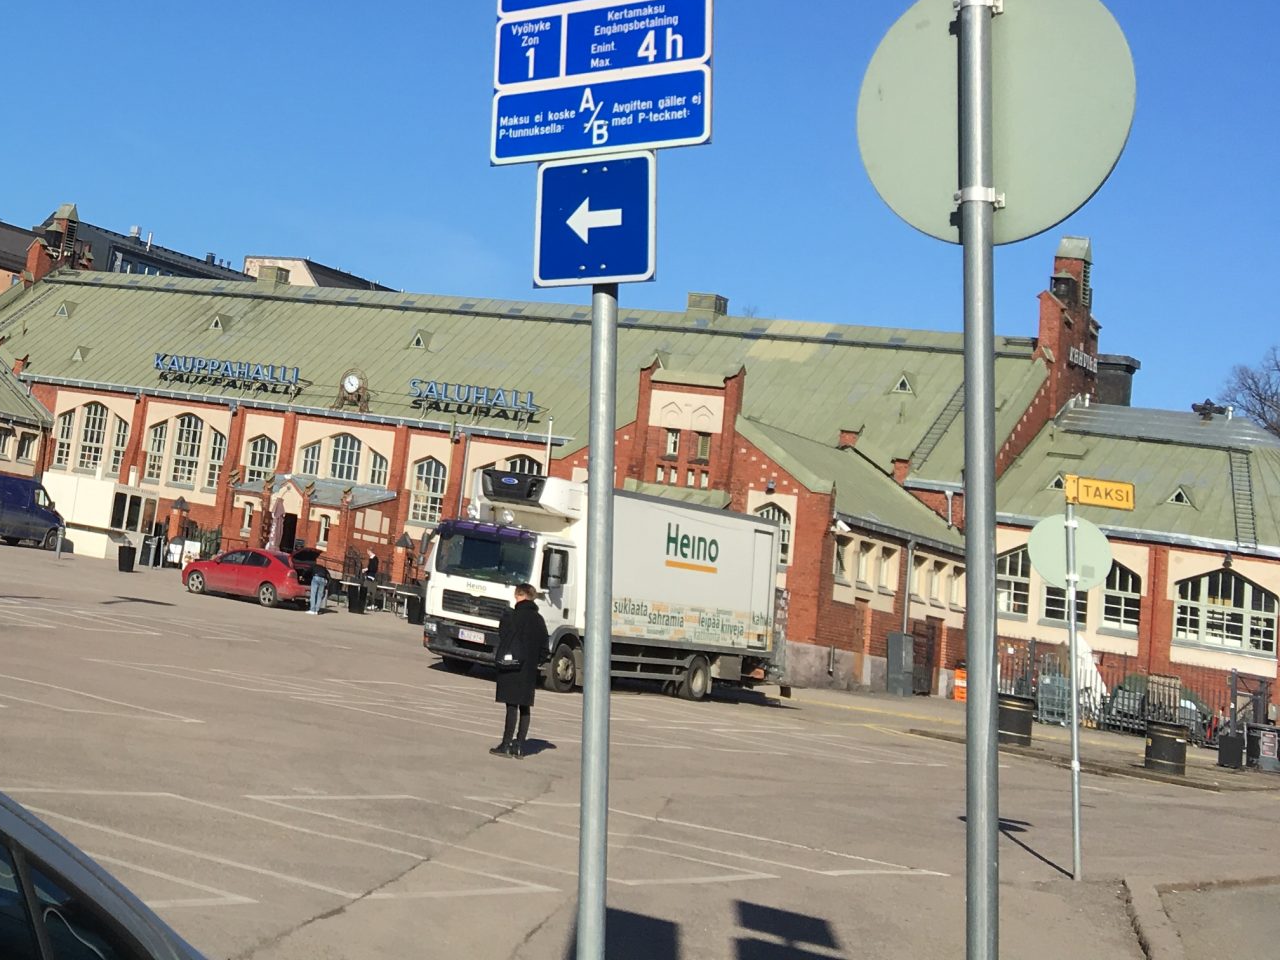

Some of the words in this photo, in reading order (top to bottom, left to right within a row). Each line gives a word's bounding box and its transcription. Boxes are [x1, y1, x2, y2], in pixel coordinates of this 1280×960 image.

[607, 4, 665, 21] Kertamaksu
[511, 20, 551, 36] Vyöhyke
[594, 15, 678, 36] Engångsbetalning
[521, 35, 539, 47] Zon
[637, 30, 657, 62] 4
[665, 27, 683, 60] h
[525, 47, 535, 79] 1
[612, 99, 653, 113] Avgiften
[658, 95, 686, 110] gäller
[691, 92, 702, 105] ej
[499, 114, 530, 127] Maksu
[534, 111, 543, 123] ei
[547, 109, 576, 121] koske
[611, 114, 633, 126] med
[153, 352, 300, 384] KAUPPAHALLI
[409, 378, 539, 412] SALUHALL
[1083, 484, 1129, 503] TAKSI
[666, 522, 719, 563] Heino
[466, 581, 487, 592] Heino
